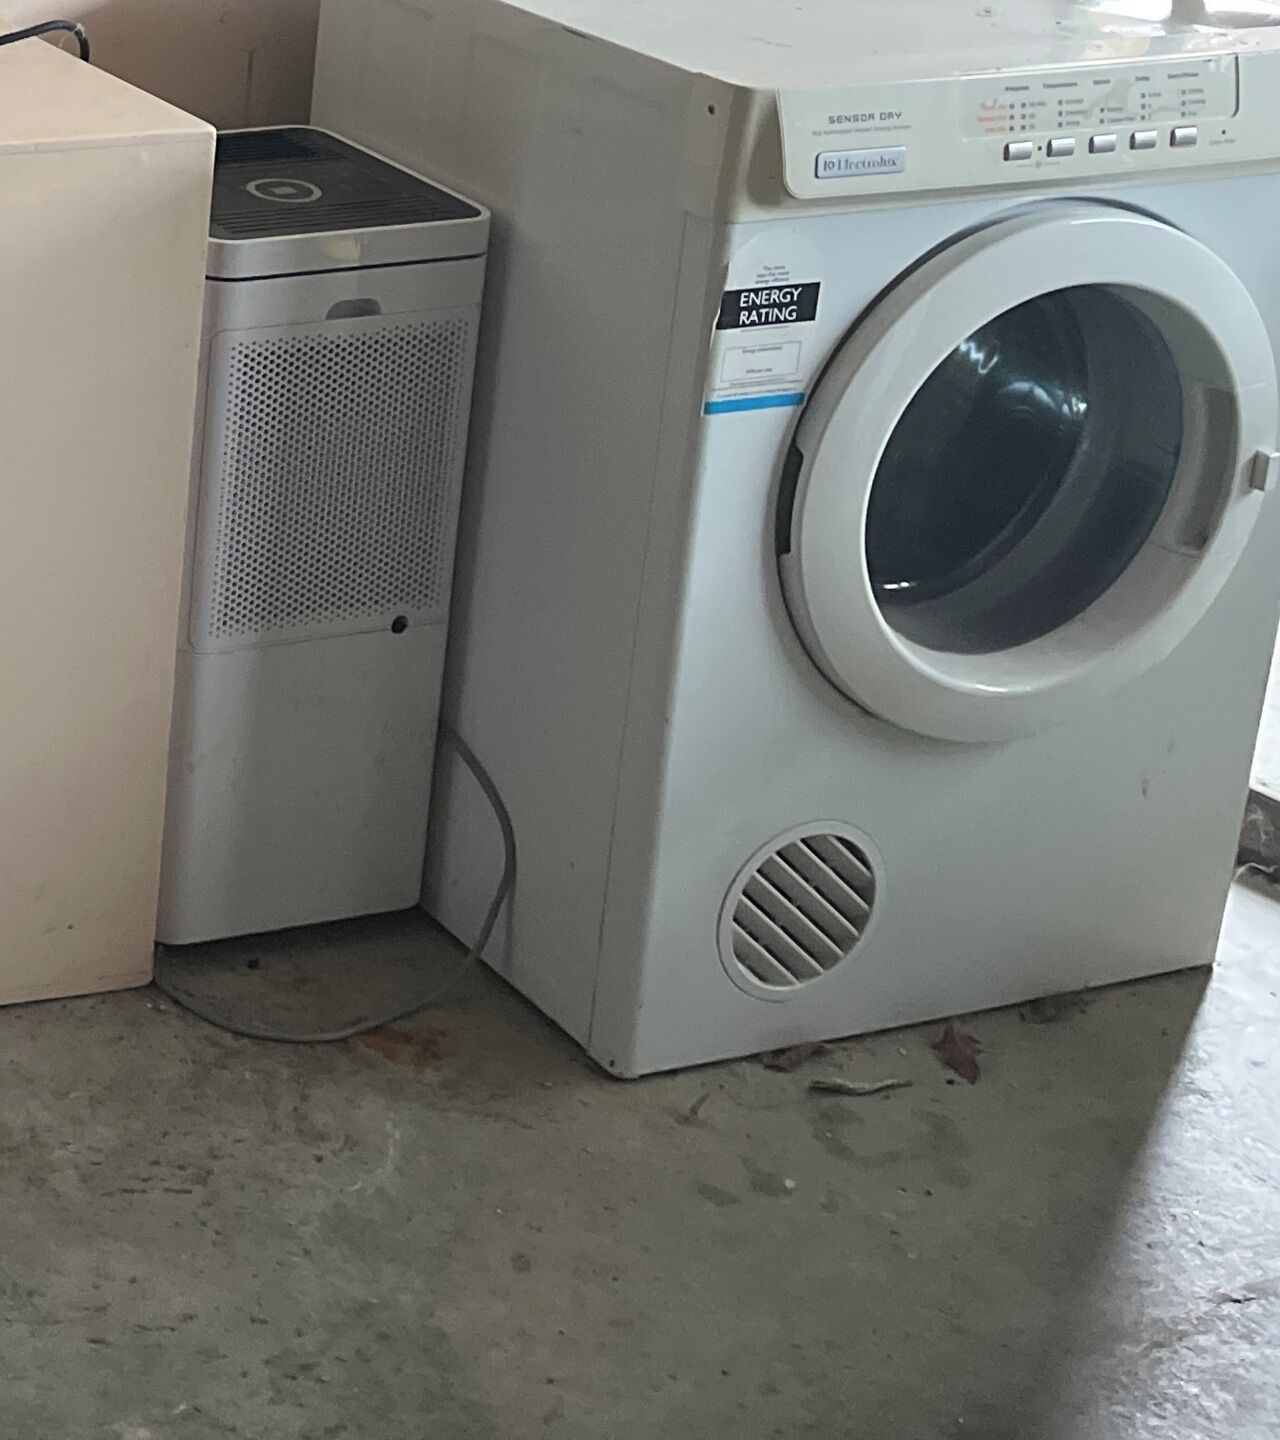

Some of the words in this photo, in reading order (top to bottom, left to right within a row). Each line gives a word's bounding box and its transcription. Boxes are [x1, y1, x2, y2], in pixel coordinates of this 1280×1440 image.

[828, 113, 875, 125] SENSOR
[879, 111, 903, 121] DRY
[740, 287, 803, 307] ENERGY
[739, 305, 798, 326] RATING
